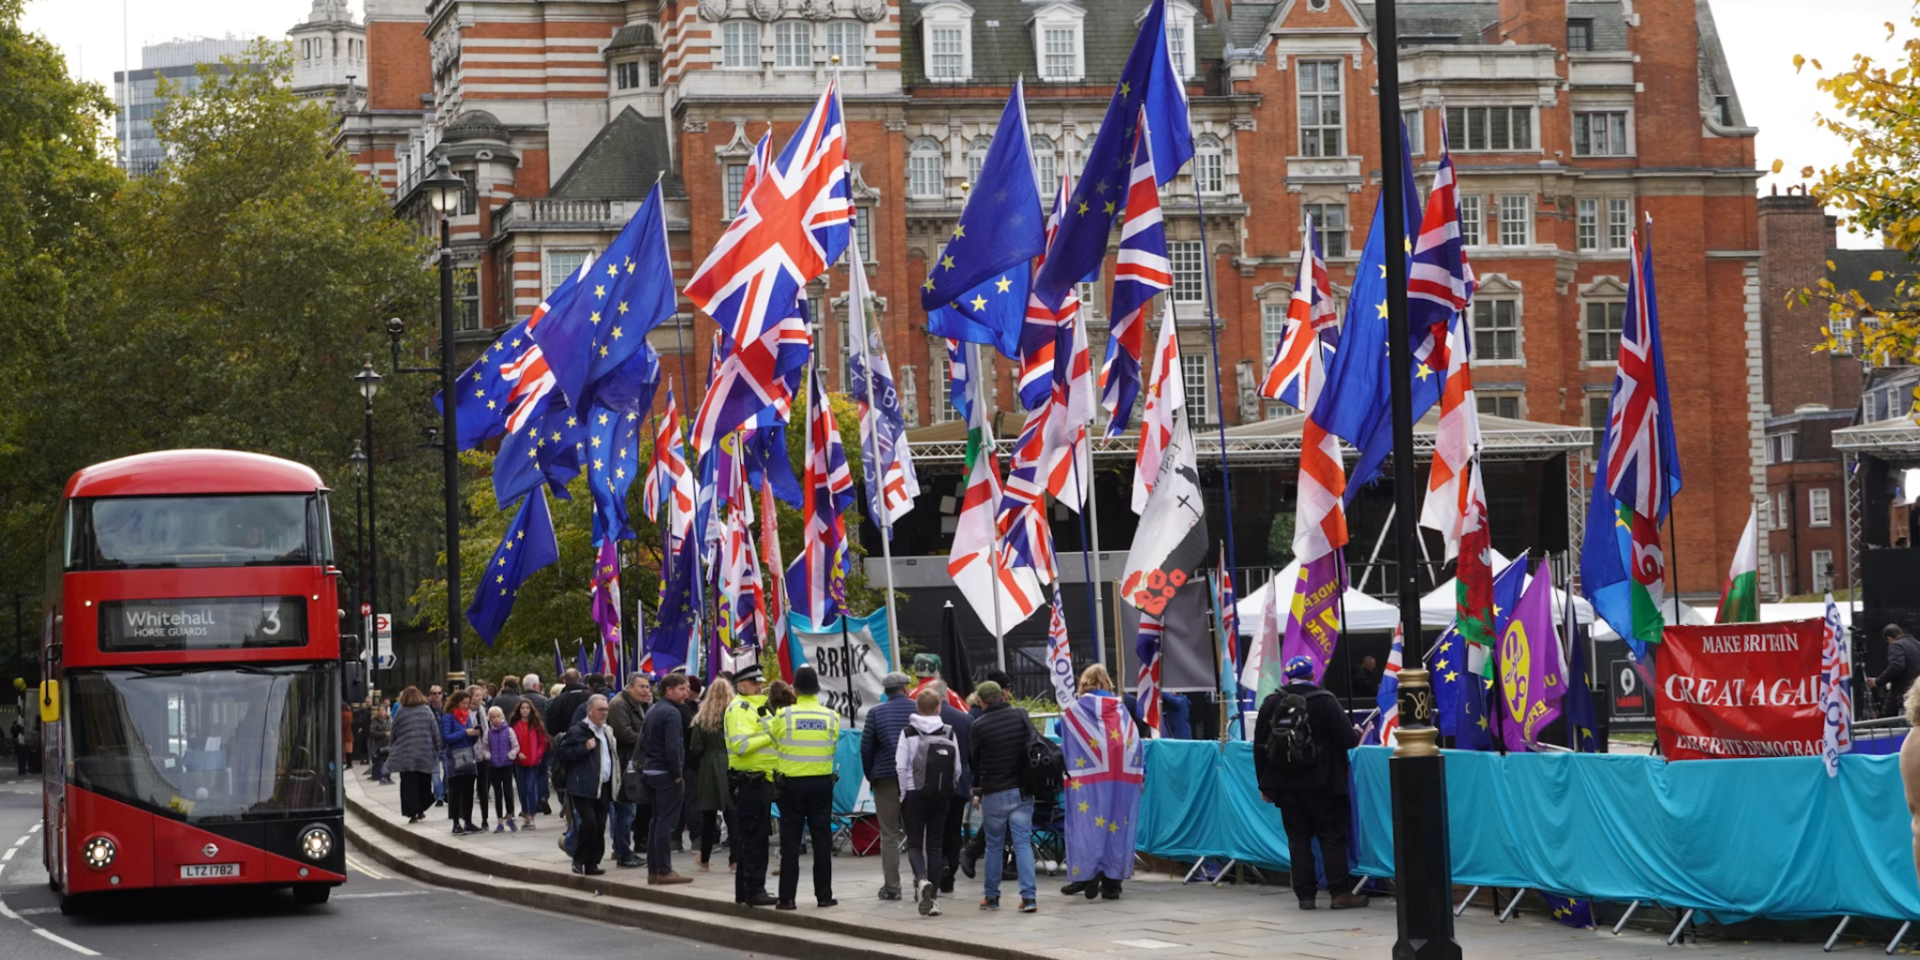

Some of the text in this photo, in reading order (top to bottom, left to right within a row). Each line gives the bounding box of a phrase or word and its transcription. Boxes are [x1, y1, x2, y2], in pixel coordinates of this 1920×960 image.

[126, 609, 215, 626] Whitehall
[361, 604, 371, 614] M
[262, 606, 281, 635] 3
[134, 626, 208, 637] HORSE GUARDS
[1702, 633, 1799, 653] MAKE BRITAIN
[1665, 673, 1823, 707] GREAT AGAI
[796, 722, 826, 730] POLICE
[1676, 733, 1746, 756] LIBERATE
[187, 865, 233, 876] LTZ 1782
